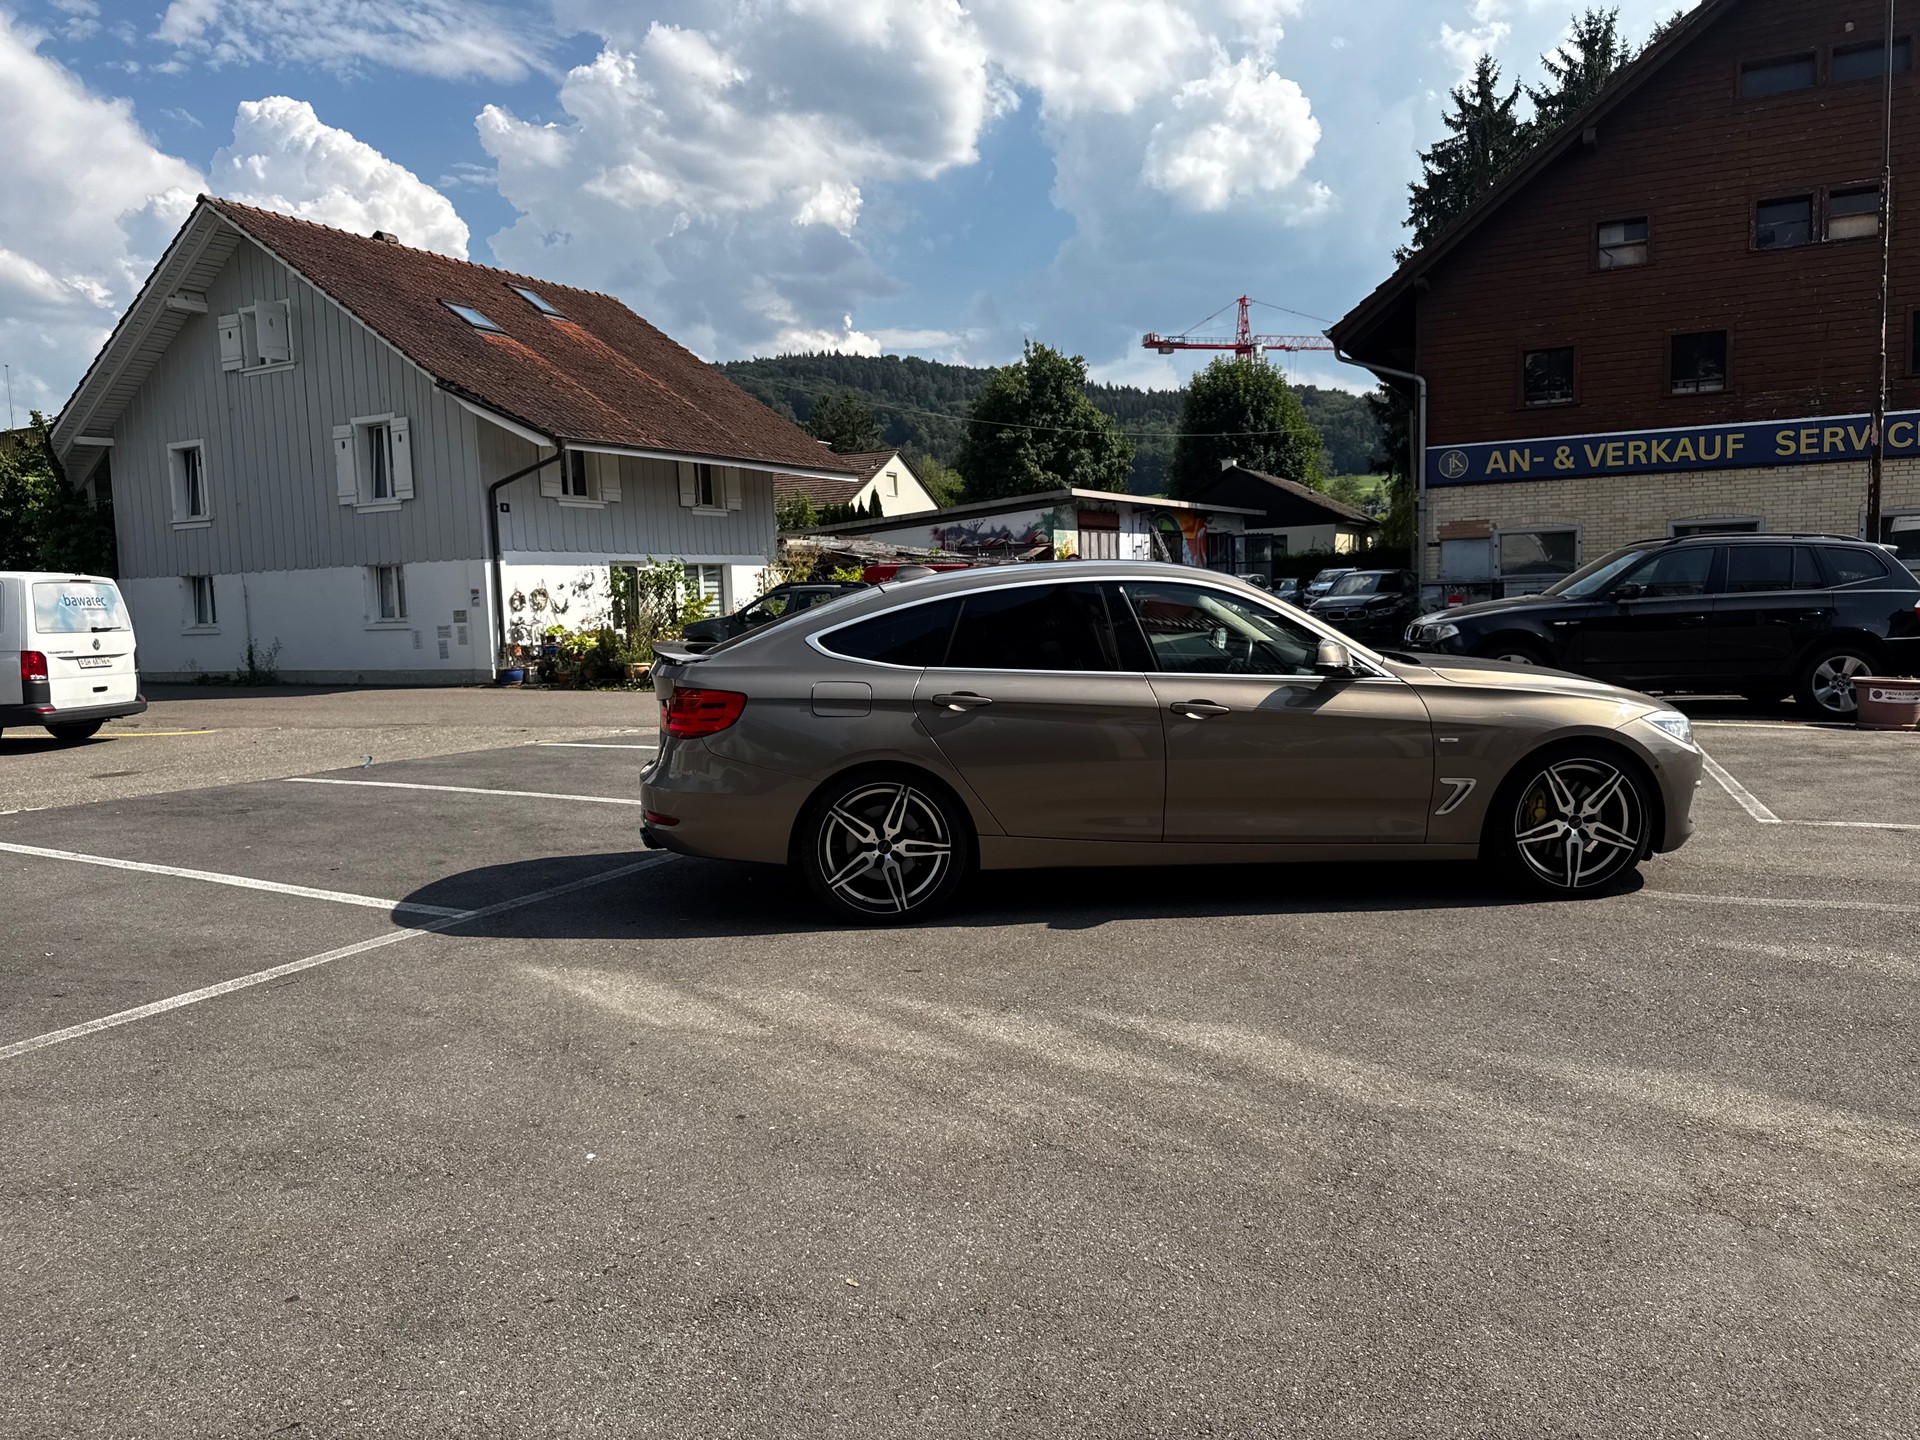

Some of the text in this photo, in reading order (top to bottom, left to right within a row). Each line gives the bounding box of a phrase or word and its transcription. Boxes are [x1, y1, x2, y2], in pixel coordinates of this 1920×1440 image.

[1485, 421, 1920, 475] AN- & VERKAUF SERVC
[62, 594, 107, 607] bawatec
